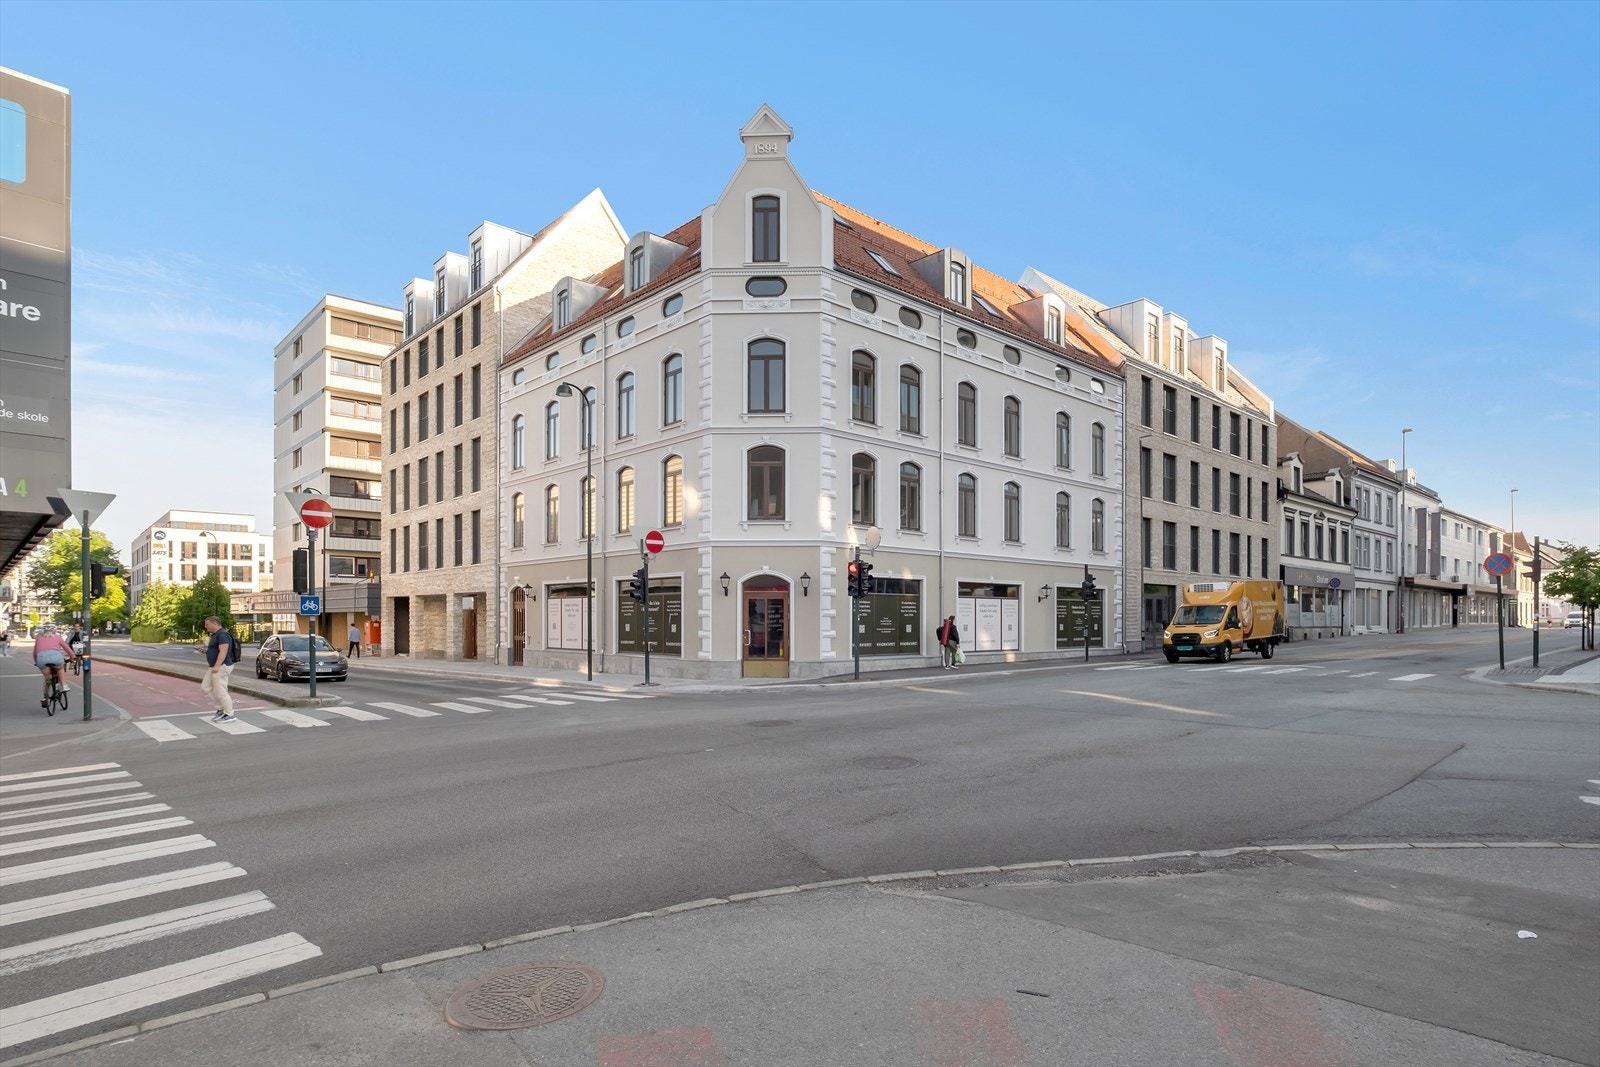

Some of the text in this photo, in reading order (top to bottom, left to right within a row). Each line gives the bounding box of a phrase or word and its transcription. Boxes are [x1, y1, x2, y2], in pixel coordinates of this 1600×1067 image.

[753, 142, 777, 154] 1894
[17, 411, 49, 423] skole
[14, 479, 27, 497] 4
